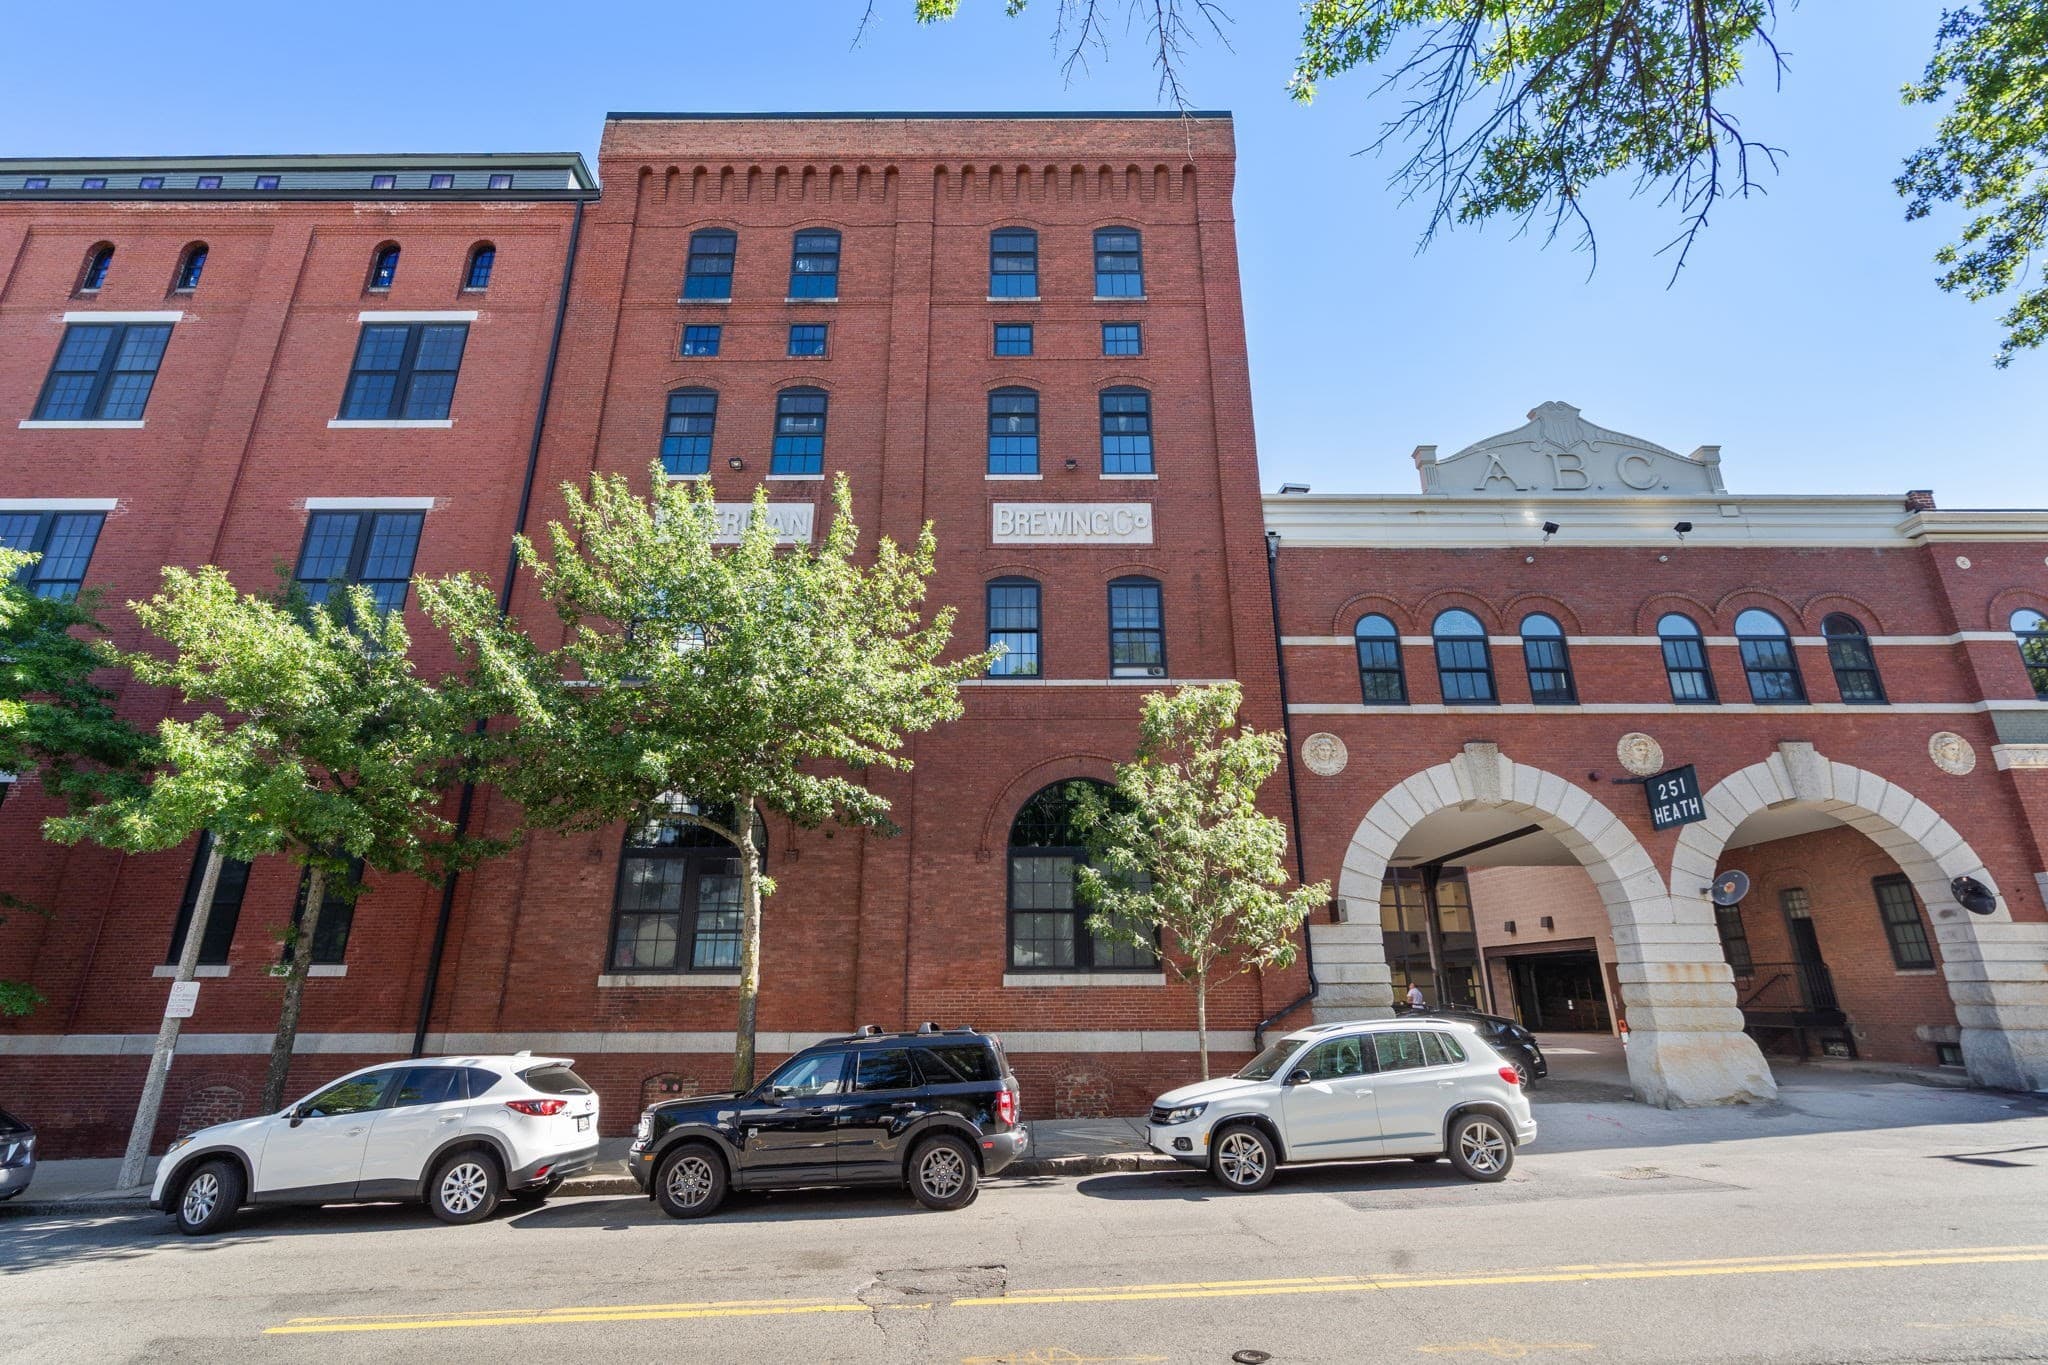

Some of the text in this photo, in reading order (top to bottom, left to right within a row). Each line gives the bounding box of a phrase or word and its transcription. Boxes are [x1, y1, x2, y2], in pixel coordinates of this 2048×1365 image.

[998, 509, 1108, 536] BREWING
[1658, 777, 1686, 800] 251
[1654, 798, 1700, 824] HEATH
